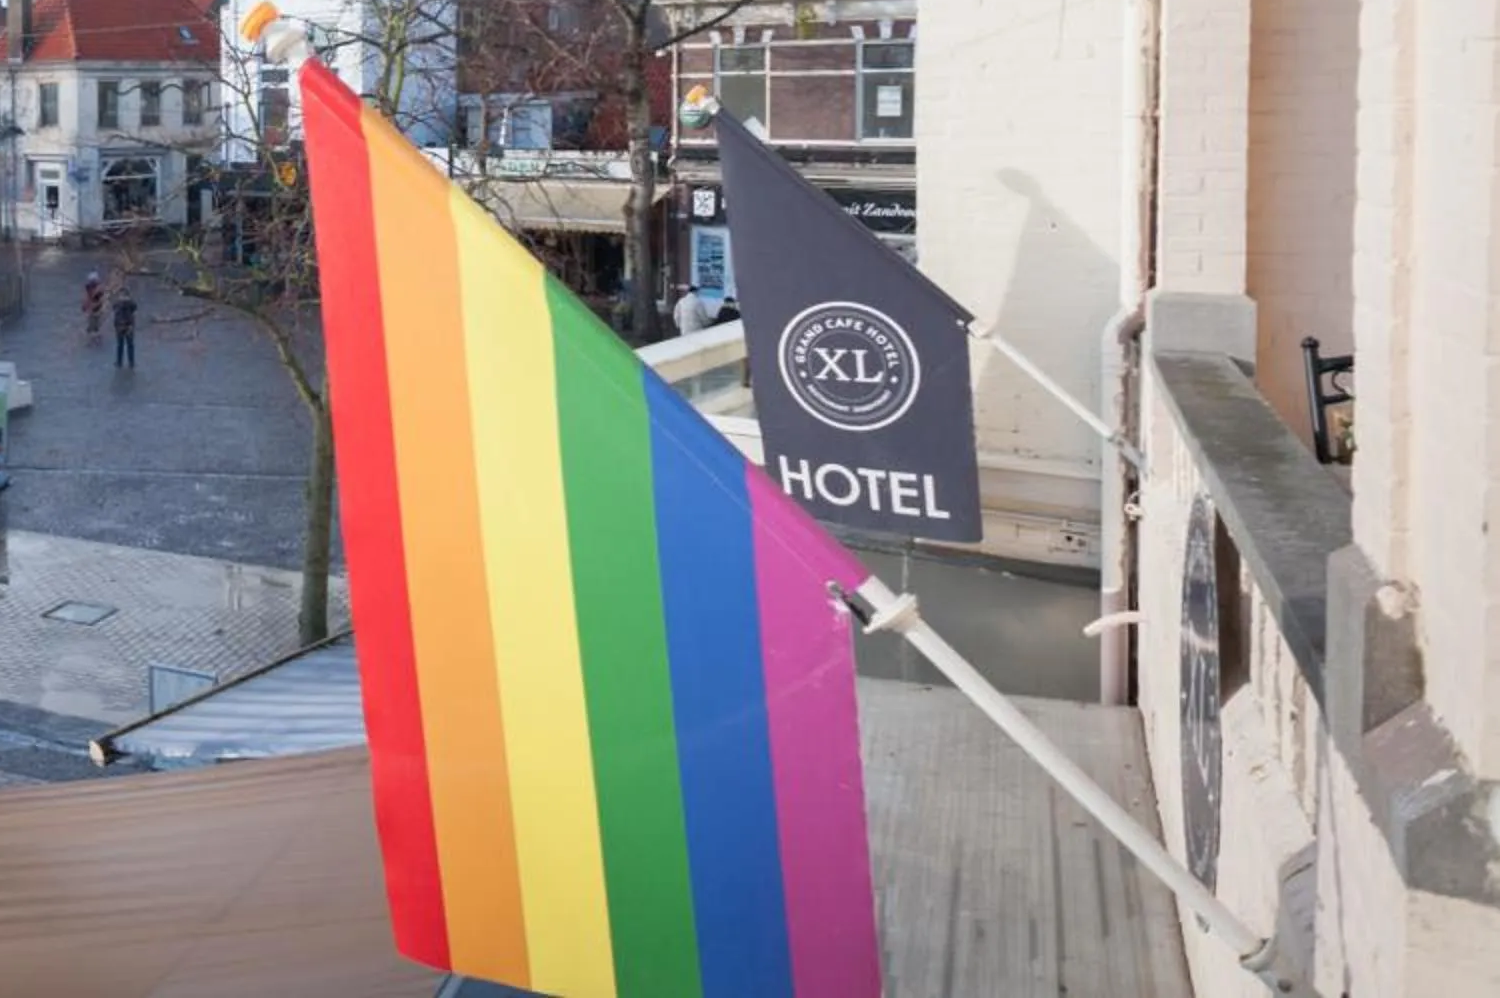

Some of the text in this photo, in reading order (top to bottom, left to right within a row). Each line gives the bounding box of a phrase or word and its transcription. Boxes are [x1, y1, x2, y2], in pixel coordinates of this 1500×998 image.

[795, 323, 824, 364] GRAND
[866, 326, 900, 369] HOTEL
[814, 347, 884, 383] XL
[779, 455, 951, 520] HOTEL
